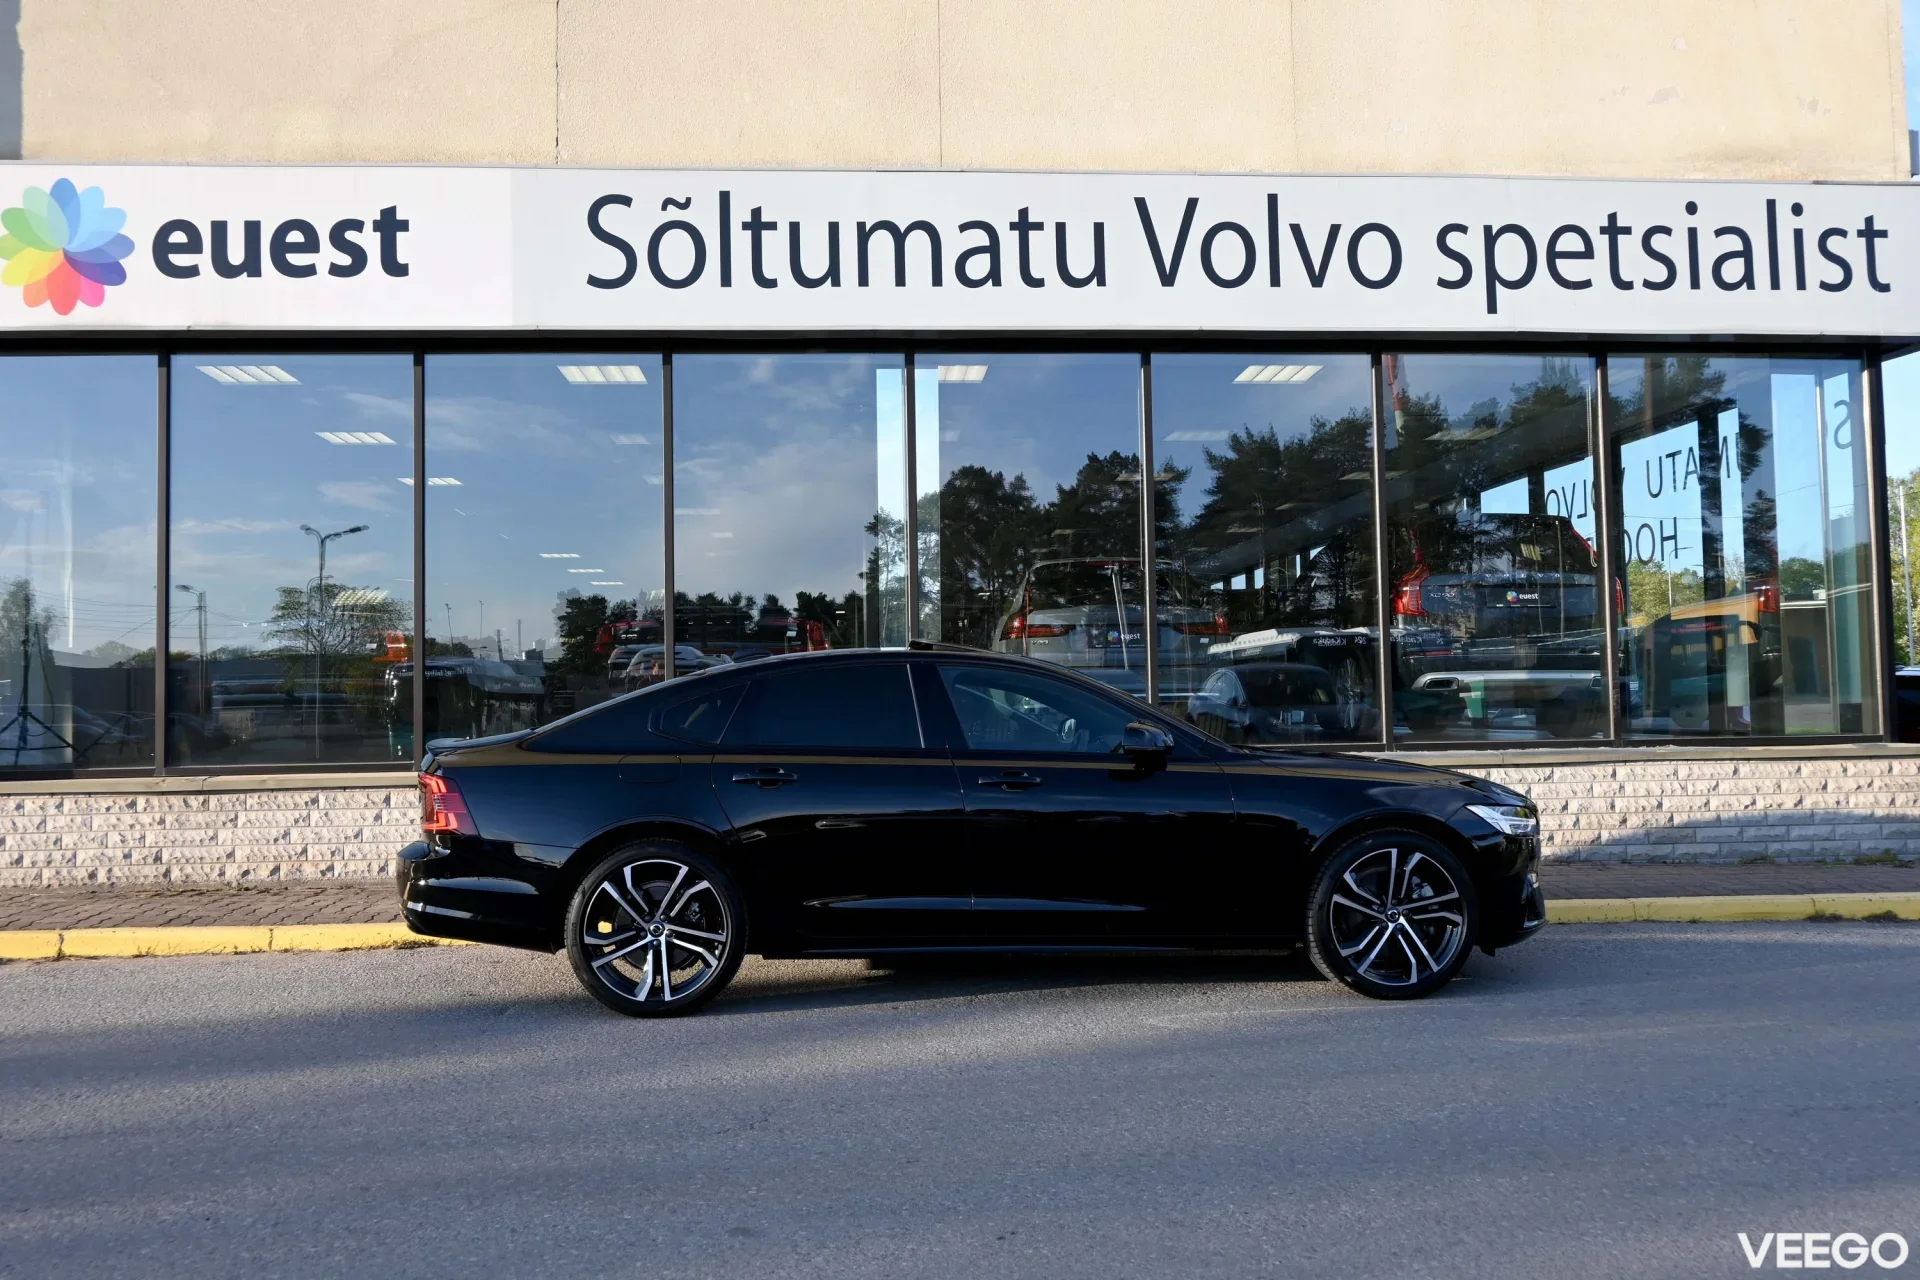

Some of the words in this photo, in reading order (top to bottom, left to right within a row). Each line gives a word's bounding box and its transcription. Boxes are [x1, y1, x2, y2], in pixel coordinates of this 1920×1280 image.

[153, 206, 409, 278] euest
[587, 191, 1107, 289] Sõltumatu
[1134, 194, 1402, 289] Volvo
[1437, 199, 1891, 314] spetsialist
